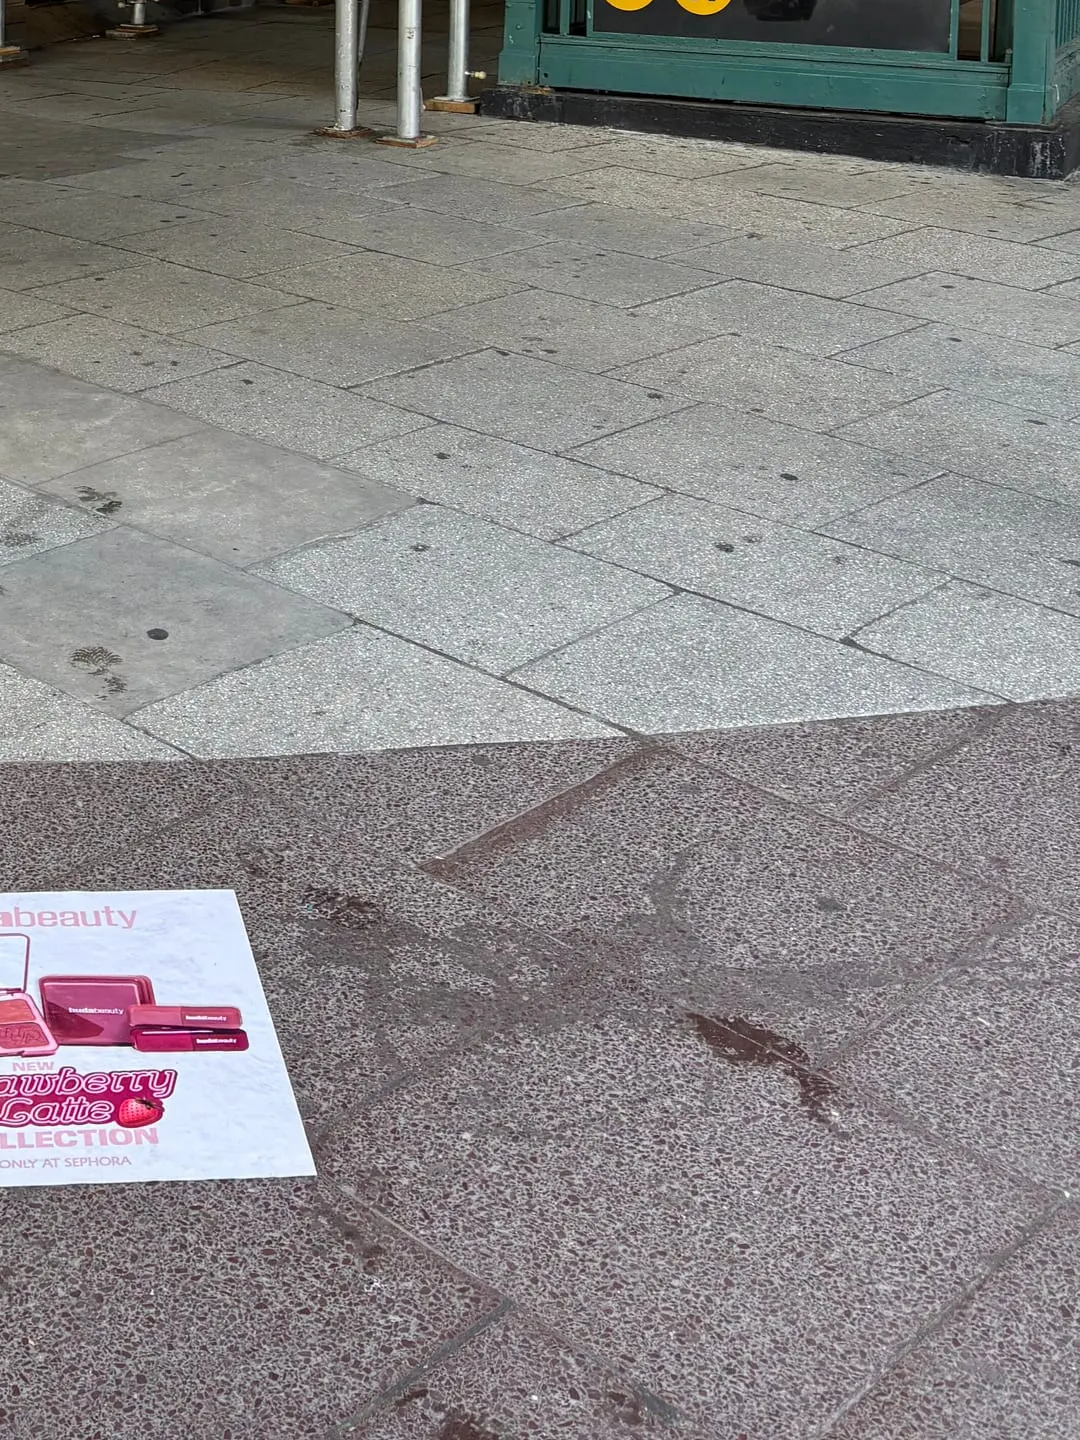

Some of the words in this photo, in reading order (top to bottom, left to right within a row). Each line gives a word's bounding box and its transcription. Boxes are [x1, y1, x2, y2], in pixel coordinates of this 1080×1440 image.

[68, 1007, 124, 1015] hudabeauty
[12, 1061, 55, 1072] NEW
[41, 1158, 60, 1169] AT
[64, 1156, 132, 1168] SEPHORA
